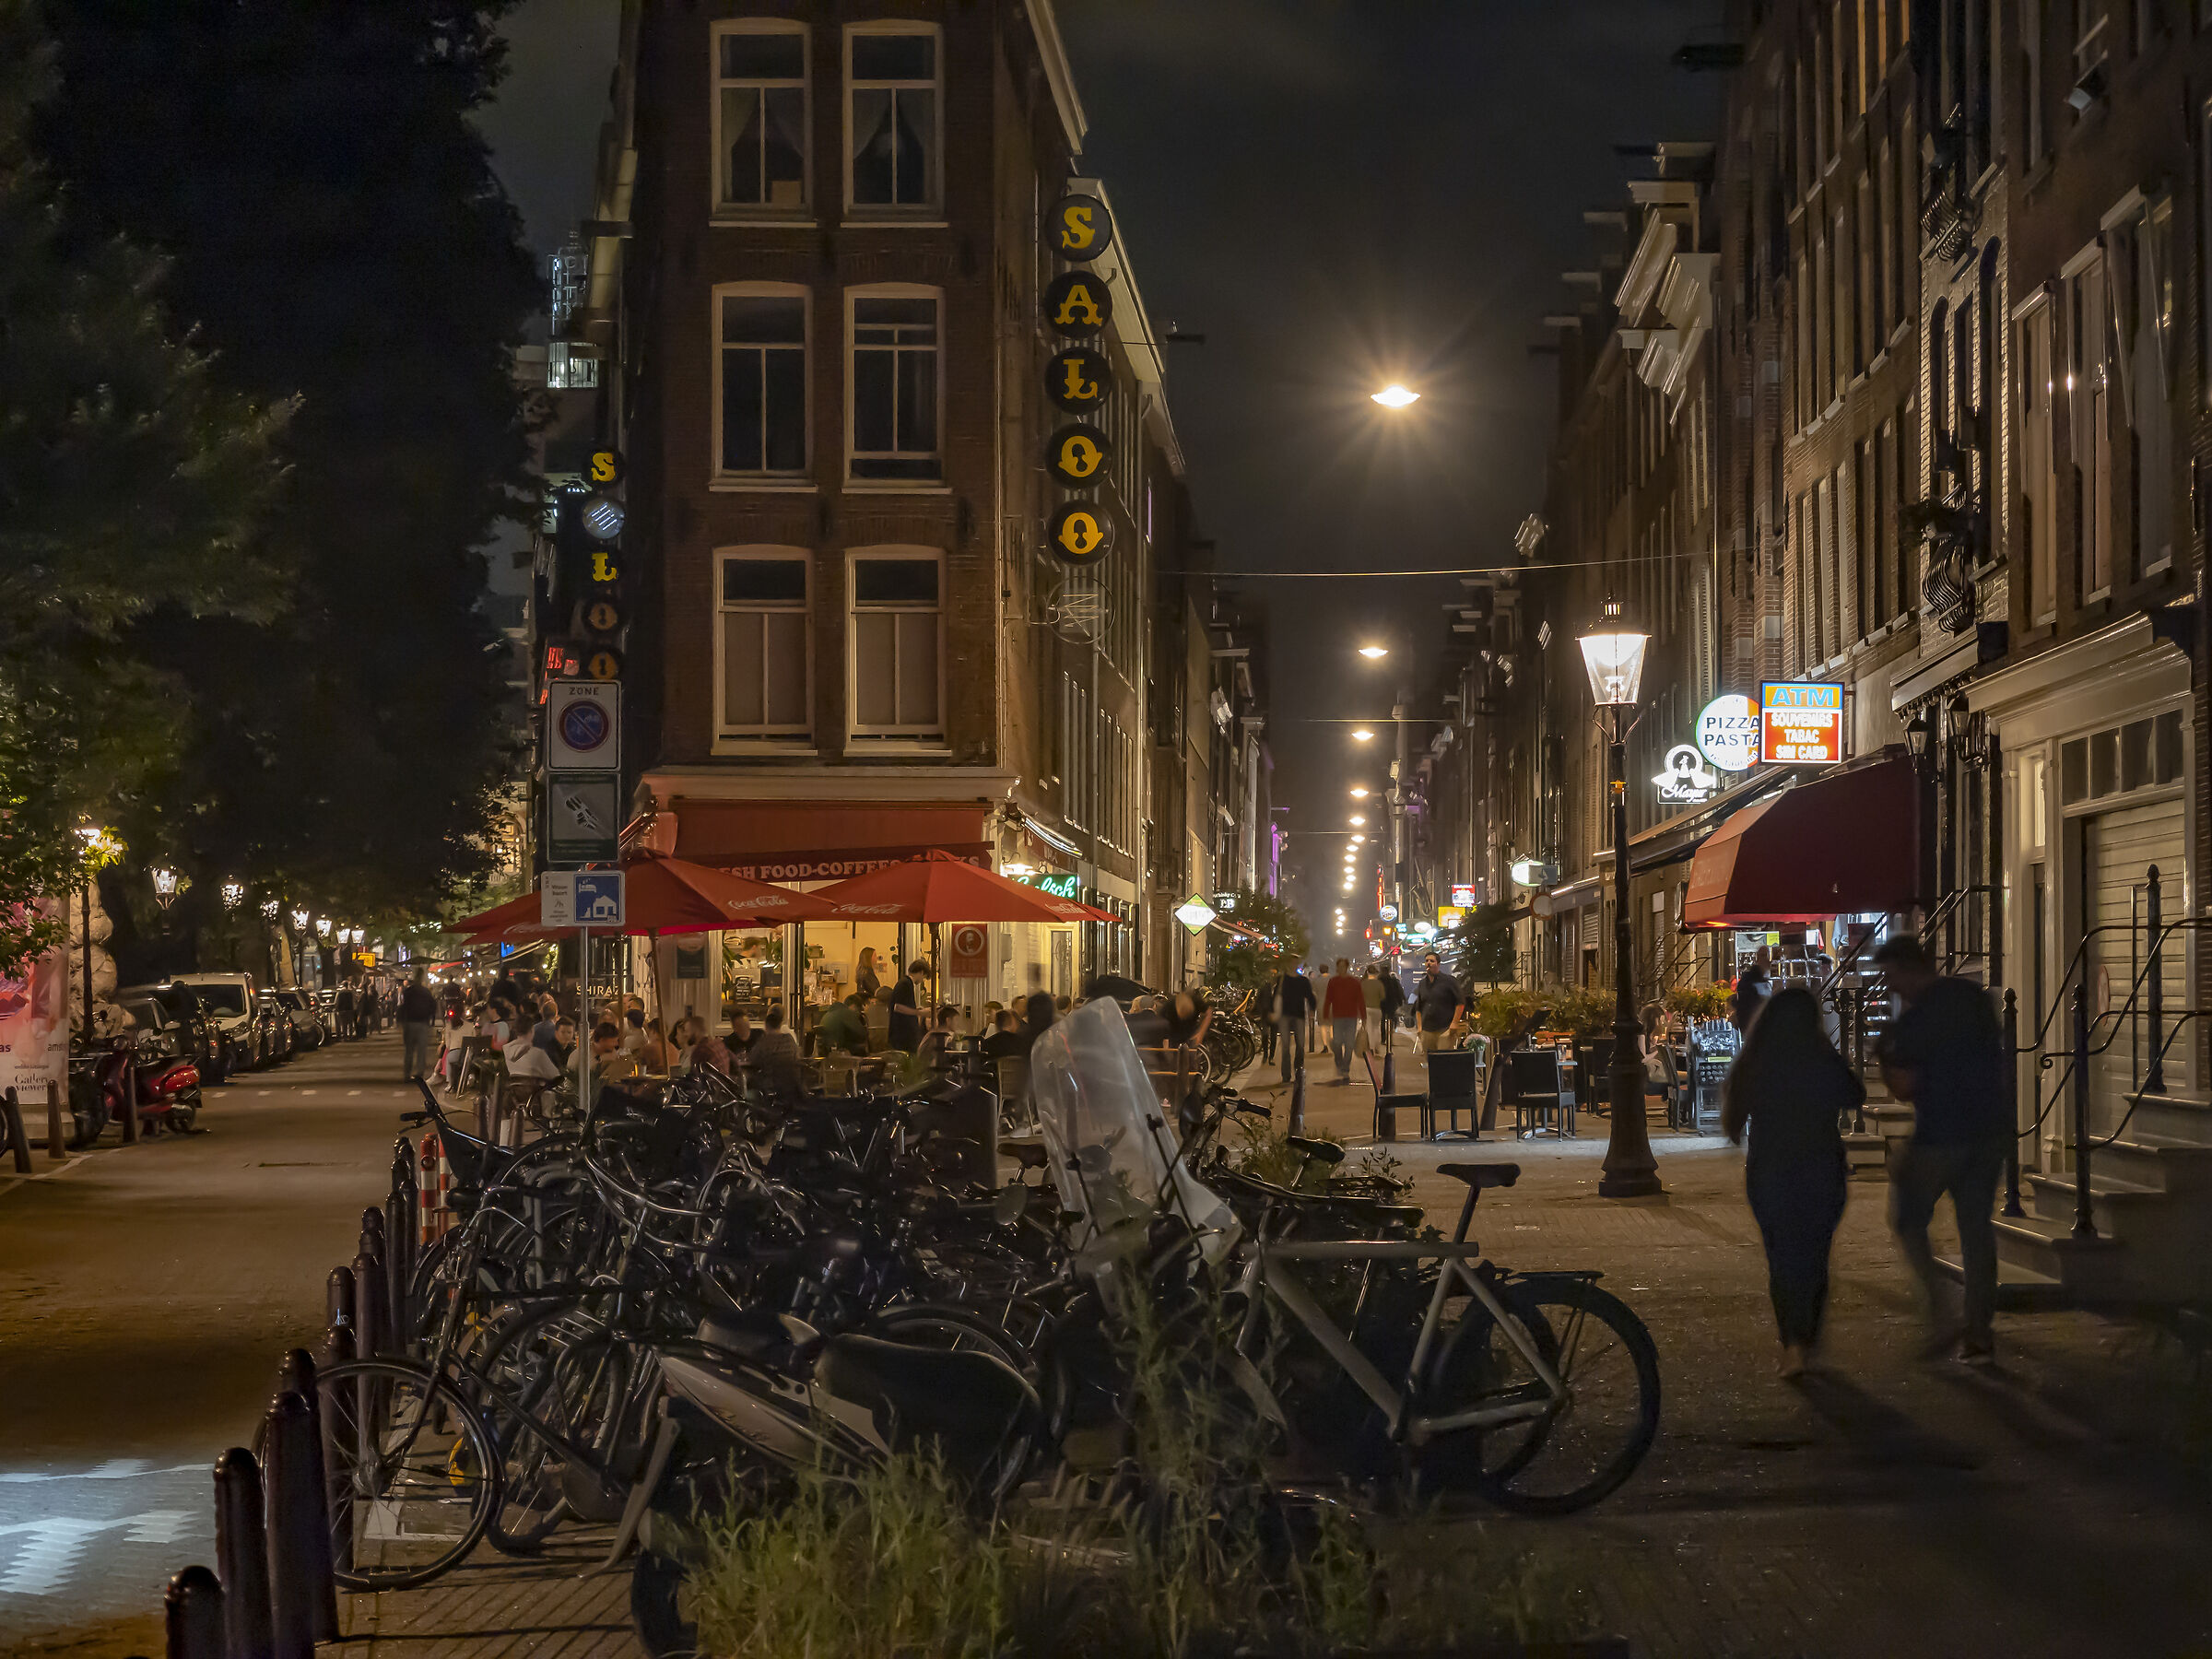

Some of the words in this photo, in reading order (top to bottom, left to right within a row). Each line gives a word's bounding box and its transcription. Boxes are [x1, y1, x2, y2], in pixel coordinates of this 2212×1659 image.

[569, 687, 599, 696] ZONE
[1771, 688, 1833, 706] ATM
[1706, 717, 1759, 729] PIZZA
[1771, 712, 1833, 727] SOUVENIRS
[1704, 734, 1759, 746] PASTA
[1783, 729, 1820, 743] TABAC
[1775, 745, 1796, 759] SIM
[1797, 745, 1828, 759] CARD
